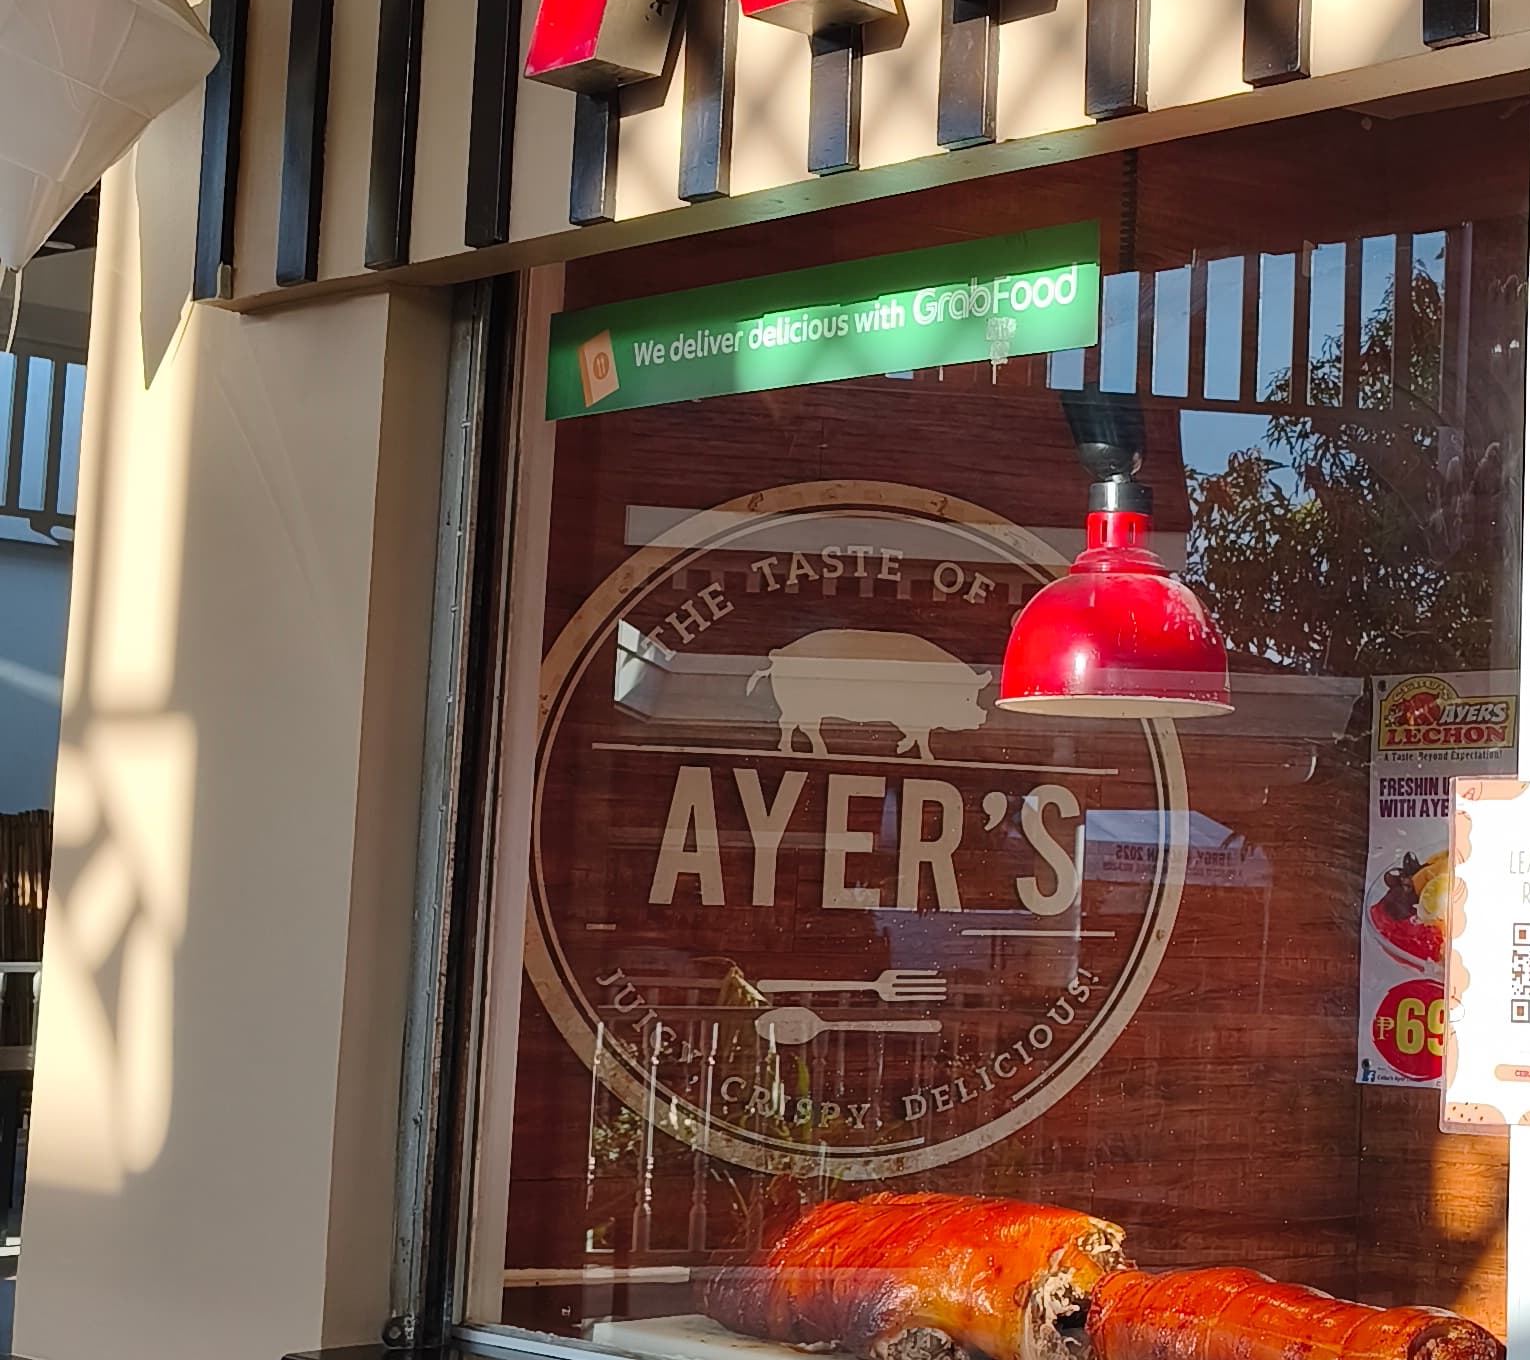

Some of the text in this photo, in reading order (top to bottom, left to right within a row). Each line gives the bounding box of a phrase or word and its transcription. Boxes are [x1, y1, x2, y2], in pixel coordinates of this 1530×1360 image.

[633, 262, 1079, 368] We deliver delicious with GrabFood
[638, 545, 997, 663] THE TASTE OF
[1385, 725, 1508, 746] LECHON
[1439, 702, 1509, 725] AYERS
[1380, 777, 1439, 797] FRESHIN
[1380, 799, 1416, 818] WITH
[647, 765, 1081, 918] AYER'S
[903, 966, 1102, 1122] DELICIOUS!
